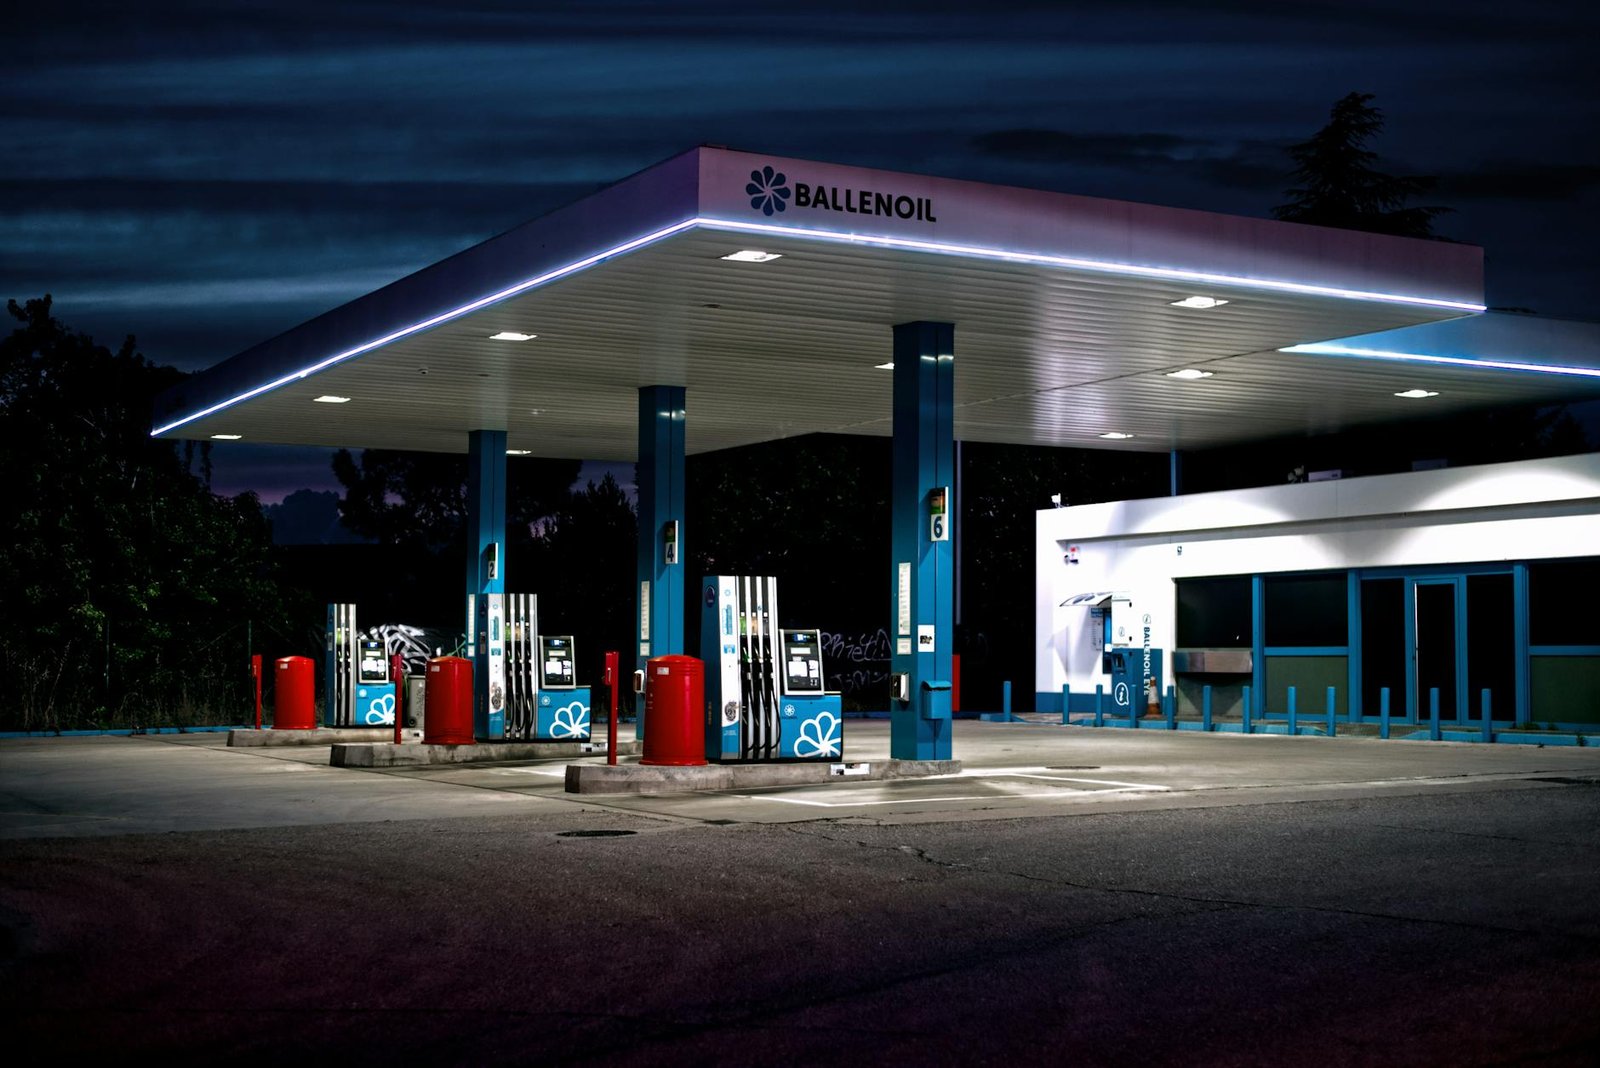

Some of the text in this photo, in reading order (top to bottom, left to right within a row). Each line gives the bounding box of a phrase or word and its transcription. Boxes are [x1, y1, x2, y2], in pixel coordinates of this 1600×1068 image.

[795, 183, 936, 222] BALLENOIL
[934, 516, 943, 538] 6
[667, 544, 674, 562] 4
[489, 563, 494, 578] 2
[1143, 626, 1151, 676] BALLENOIL
